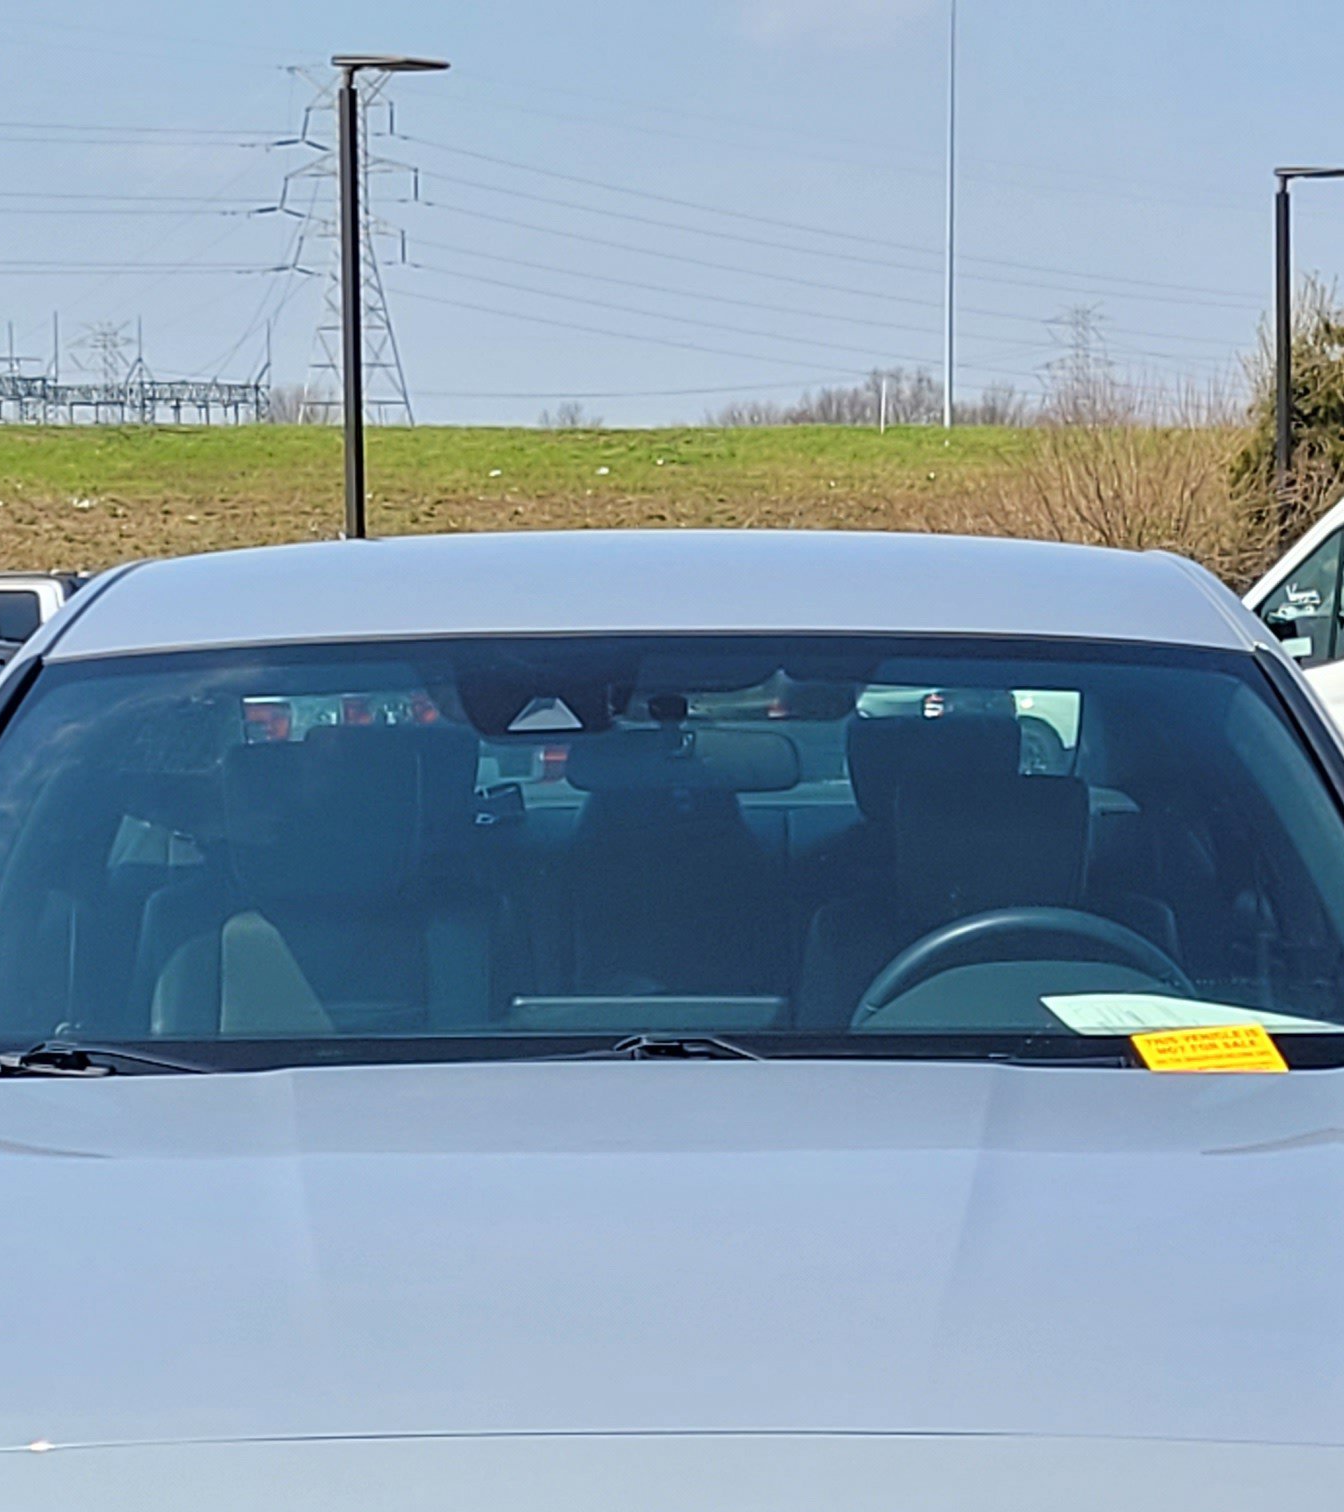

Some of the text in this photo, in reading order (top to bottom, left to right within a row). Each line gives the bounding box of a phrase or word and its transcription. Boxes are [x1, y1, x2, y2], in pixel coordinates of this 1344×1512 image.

[1183, 1029, 1241, 1042] VEHICLE
[1244, 1028, 1259, 1038] IS
[1156, 1039, 1257, 1055] NOT FOR SALE
